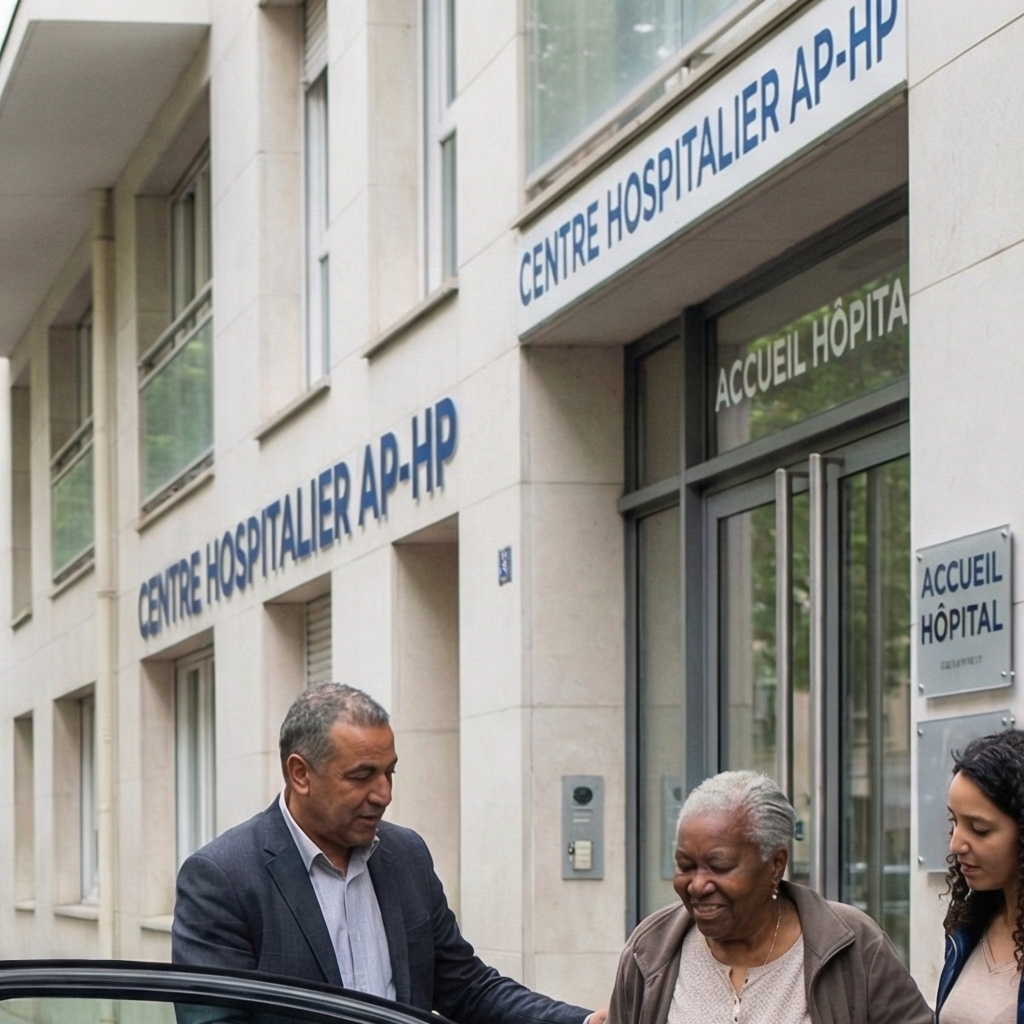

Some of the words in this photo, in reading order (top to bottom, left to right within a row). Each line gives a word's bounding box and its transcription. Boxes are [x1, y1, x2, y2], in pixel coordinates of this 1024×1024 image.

[519, 199, 601, 307] CENTRE
[606, 67, 780, 250] HOSPITALIER
[789, 0, 898, 124] AP-HP
[715, 330, 807, 413] ACCUEIL
[138, 549, 202, 639] CENTRE
[206, 460, 352, 605] HOSPITALIER
[358, 397, 459, 526] AP-HP
[921, 551, 1003, 599] ACCUEIL
[921, 600, 1004, 646] HÔPITAL
